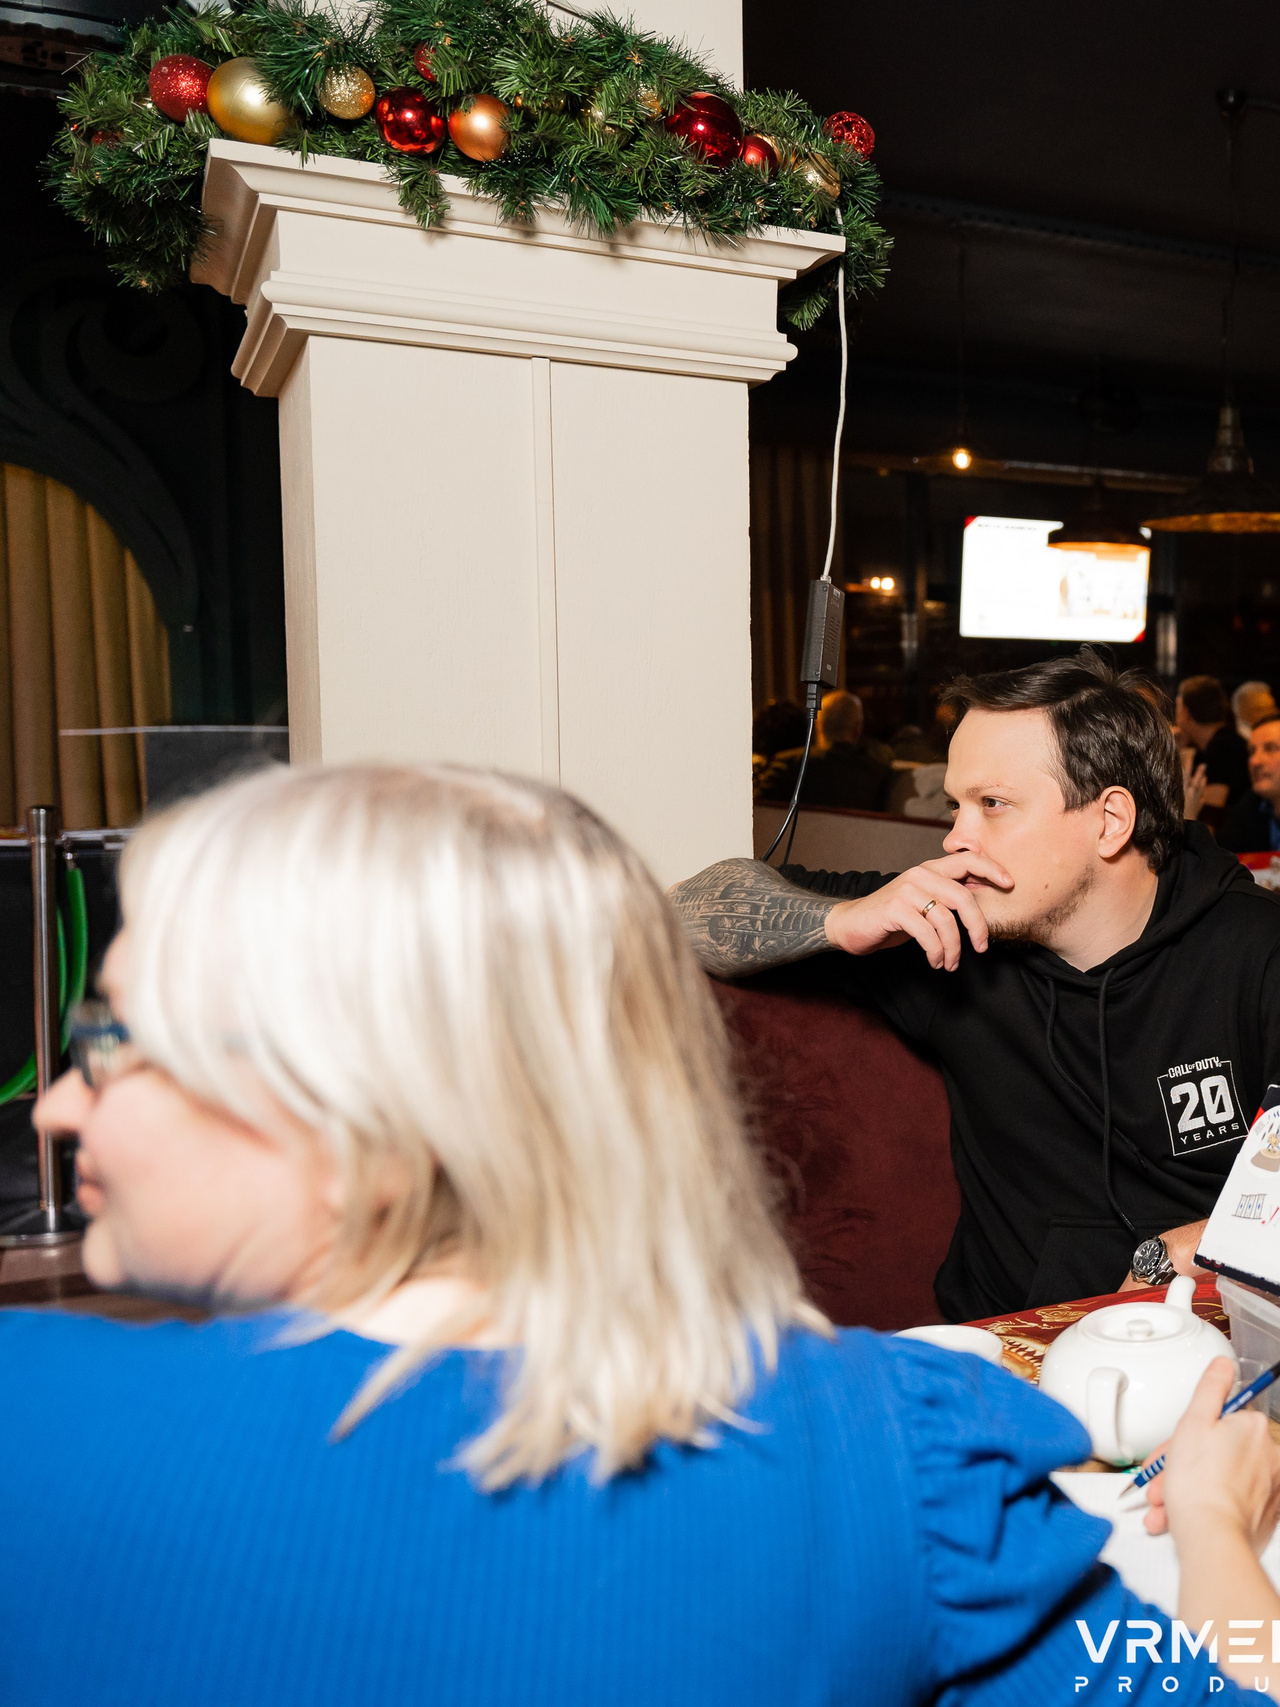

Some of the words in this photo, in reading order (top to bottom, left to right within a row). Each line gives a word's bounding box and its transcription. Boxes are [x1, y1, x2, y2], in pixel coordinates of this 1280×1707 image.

[1168, 1063, 1192, 1079] CALL
[1195, 1056, 1220, 1072] DUTY
[1170, 1074, 1235, 1134] 20
[1180, 1121, 1240, 1146] YEARS
